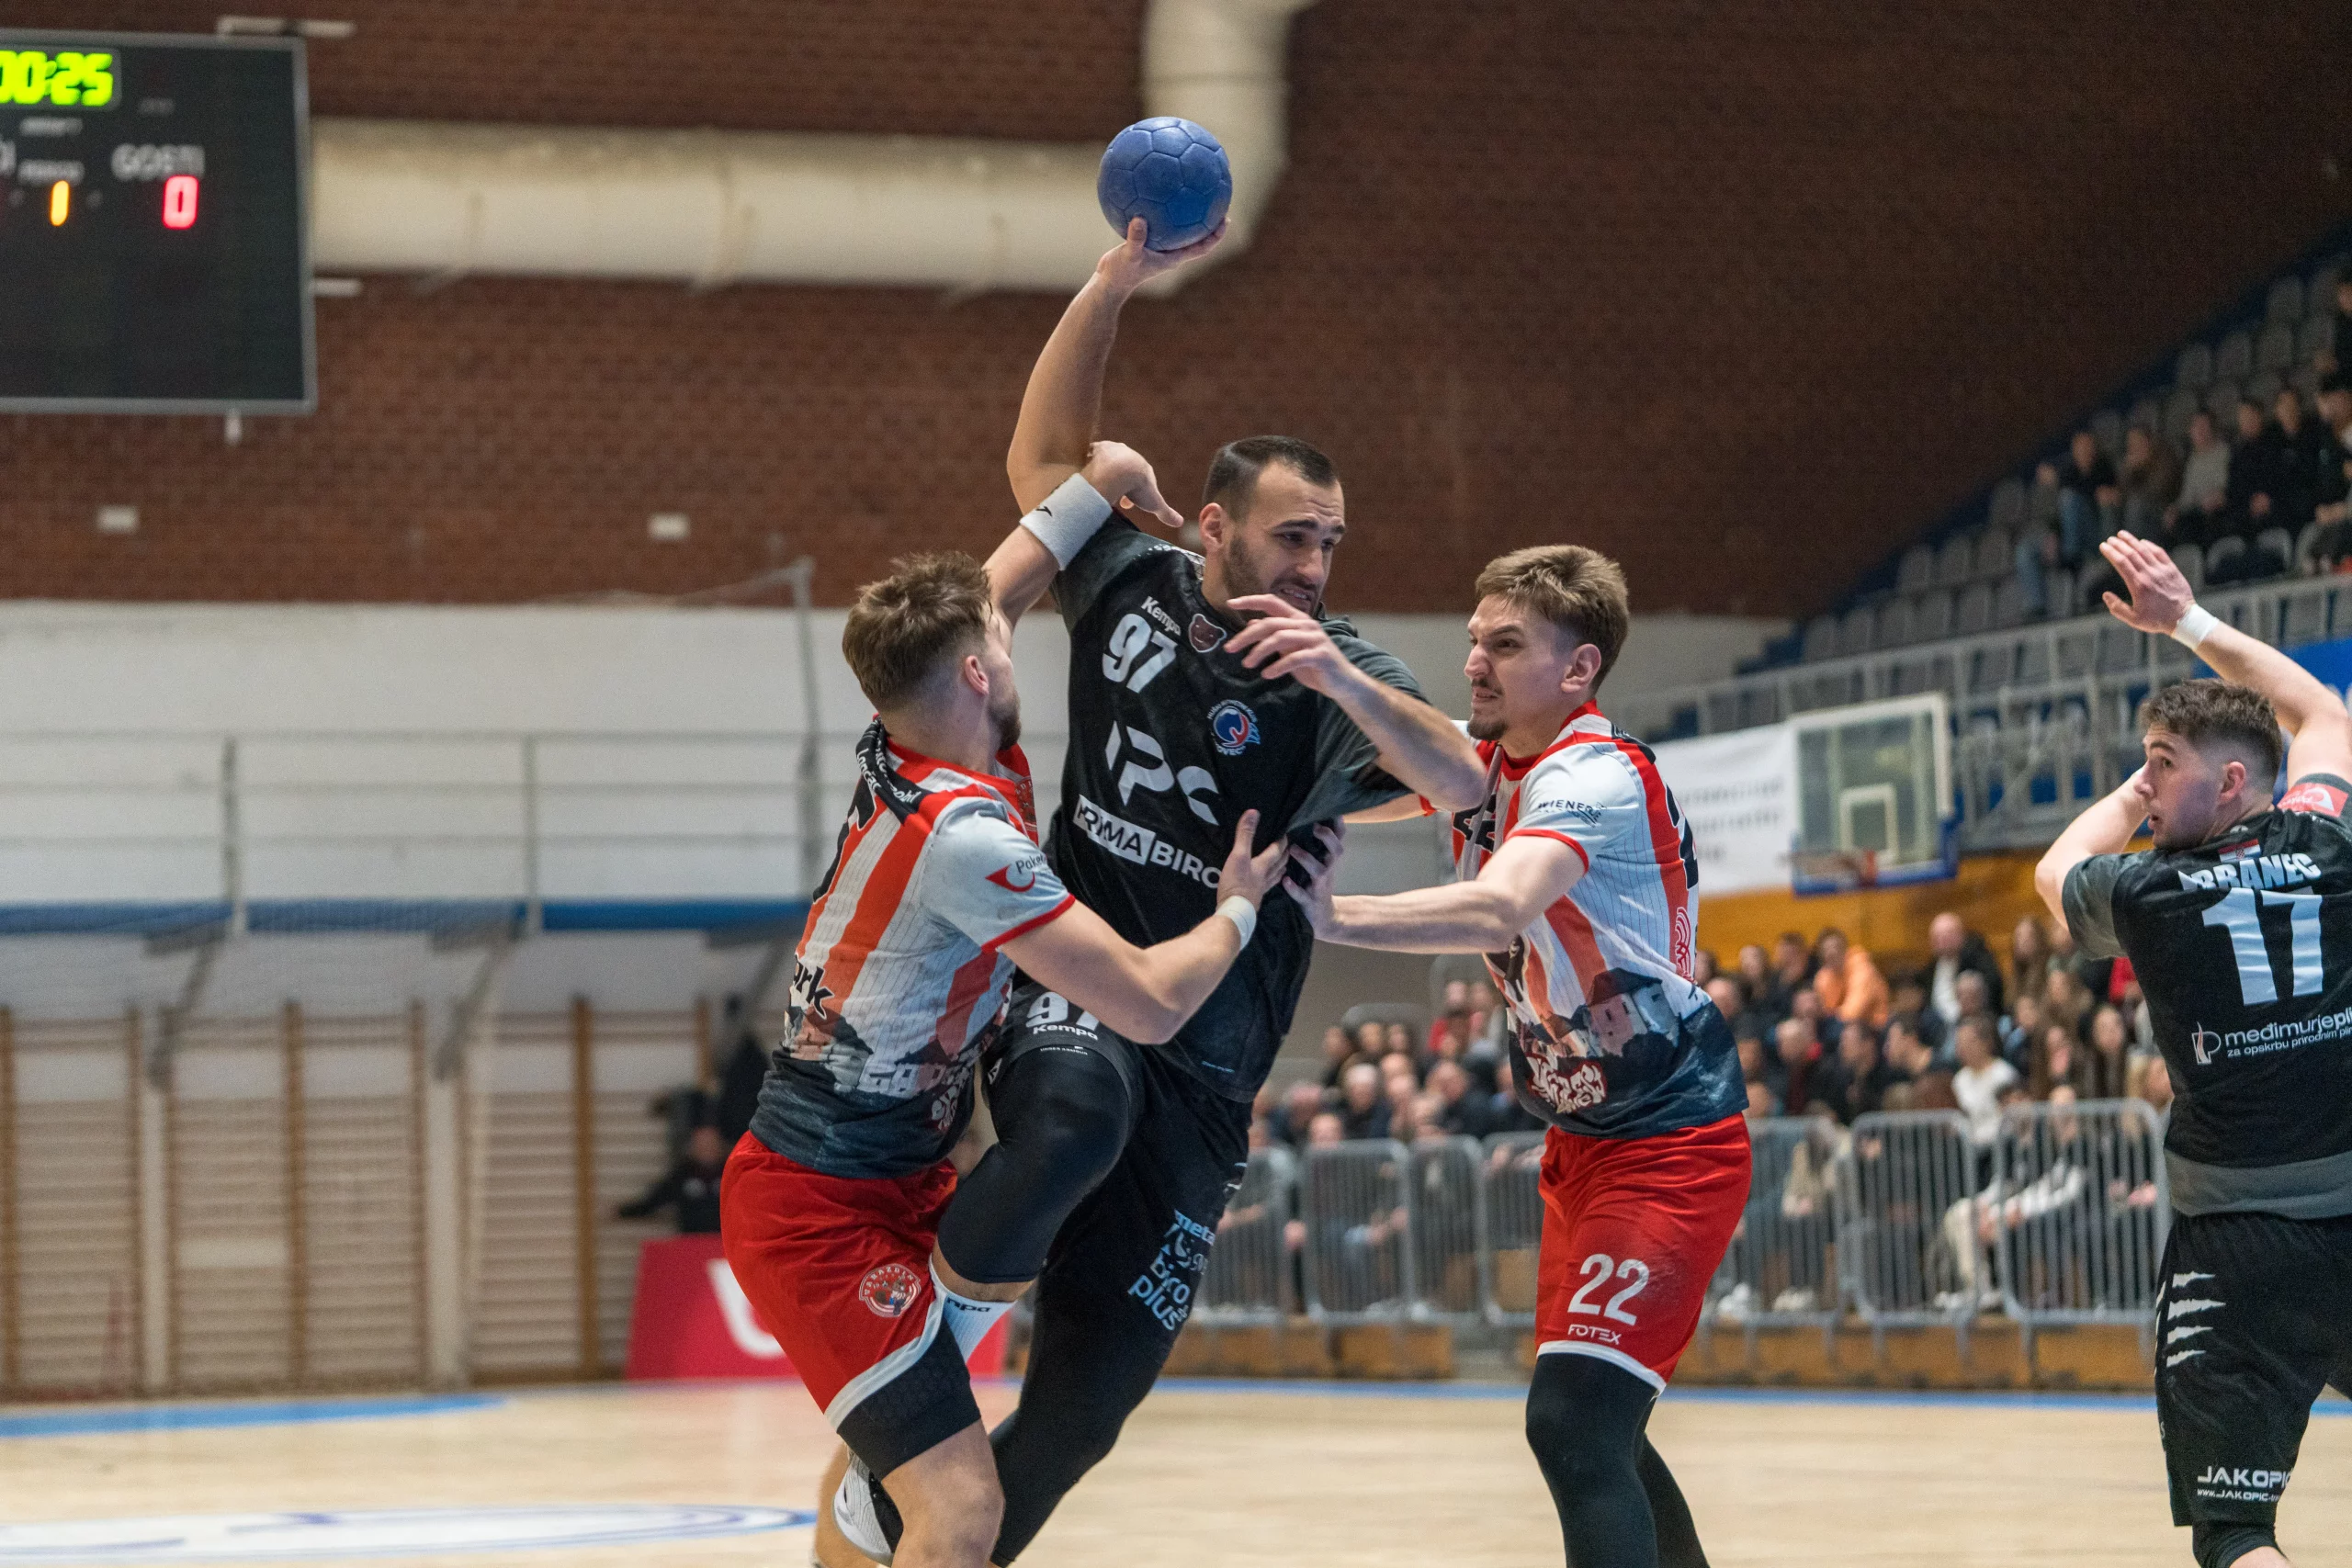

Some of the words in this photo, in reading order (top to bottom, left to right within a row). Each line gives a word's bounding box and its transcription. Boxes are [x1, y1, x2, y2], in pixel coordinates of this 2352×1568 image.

[163, 175, 199, 229] 0
[1141, 595, 1182, 636] Kempa
[1102, 613, 1178, 694] 97
[2202, 887, 2324, 1006] 17
[1033, 1023, 1099, 1041] Kempa
[2227, 1048, 2241, 1058] za
[2244, 1040, 2290, 1056] opskrbu
[2291, 1028, 2338, 1048] prirodnim
[1127, 1274, 1176, 1331] plus
[1567, 1254, 1650, 1326] 22
[1567, 1324, 1622, 1346] FOTEX
